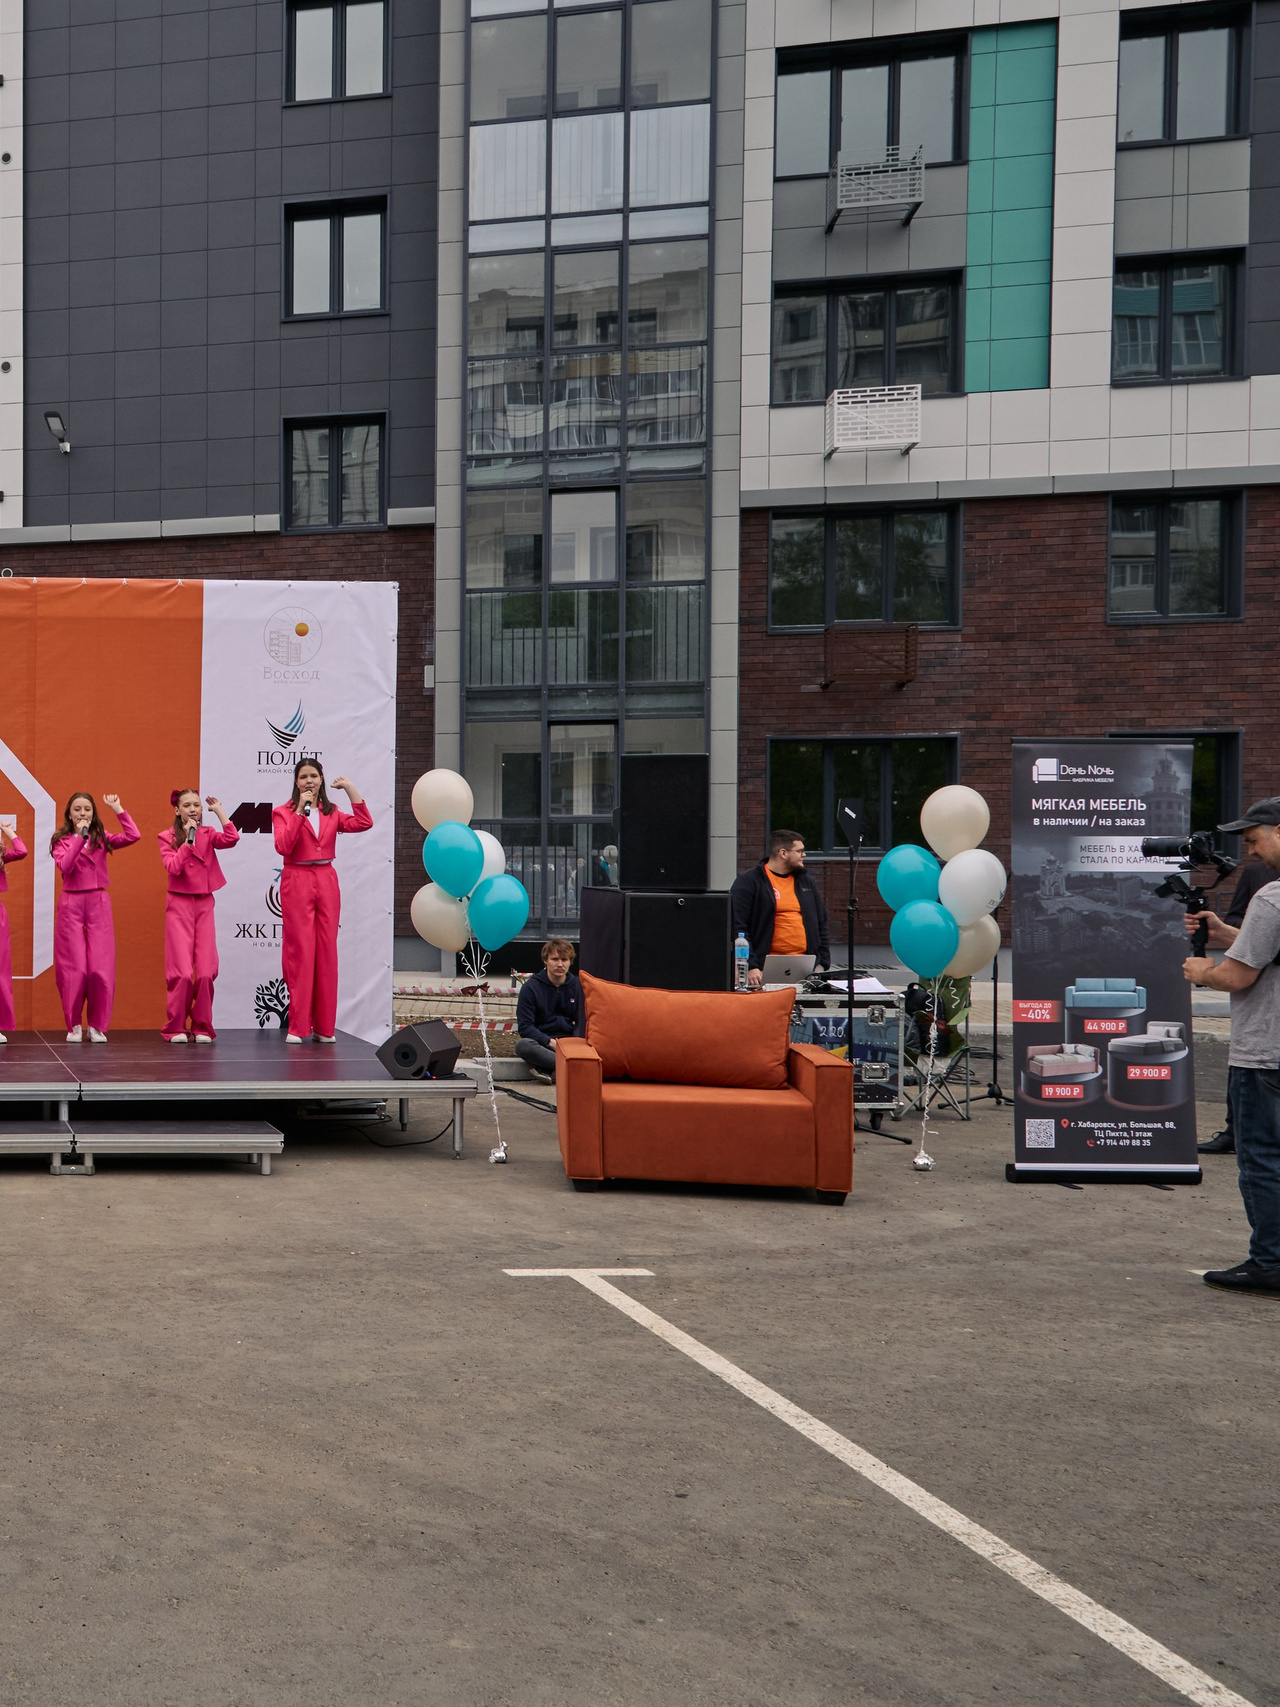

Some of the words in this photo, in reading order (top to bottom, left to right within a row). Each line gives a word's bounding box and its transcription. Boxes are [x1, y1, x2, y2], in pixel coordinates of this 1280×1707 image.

[263, 666, 320, 681] Восход
[1031, 798, 1086, 811] МЯГКАЯ
[1089, 798, 1147, 811] МЕБЕЛЬ
[1033, 818, 1040, 826] в
[1042, 818, 1089, 826] наличии
[1090, 815, 1097, 827] /
[1099, 818, 1112, 826] на
[1114, 818, 1146, 826] заказ
[1080, 844, 1117, 853] МЕБЕЛЬ
[1119, 844, 1126, 853] В
[1080, 856, 1109, 864] СТАЛА
[1111, 856, 1124, 864] ПО
[234, 923, 268, 939] ЖК
[1021, 1009, 1051, 1020] -40%
[1087, 1022, 1098, 1031] 44
[1100, 1022, 1117, 1031] 900
[1118, 1022, 1125, 1031] ₽
[1129, 1068, 1141, 1077] 29
[1142, 1068, 1159, 1077] 900
[1160, 1068, 1168, 1077] ₽
[1044, 1087, 1054, 1096] 19
[1055, 1087, 1071, 1096] 900
[1073, 1087, 1080, 1096] ₽
[1077, 1121, 1117, 1130] Хабаровск,
[1129, 1121, 1163, 1129] Большая,
[1164, 1121, 1176, 1129] 88,
[1094, 1130, 1105, 1138] ТЦ
[1105, 1130, 1129, 1138] Пихта,
